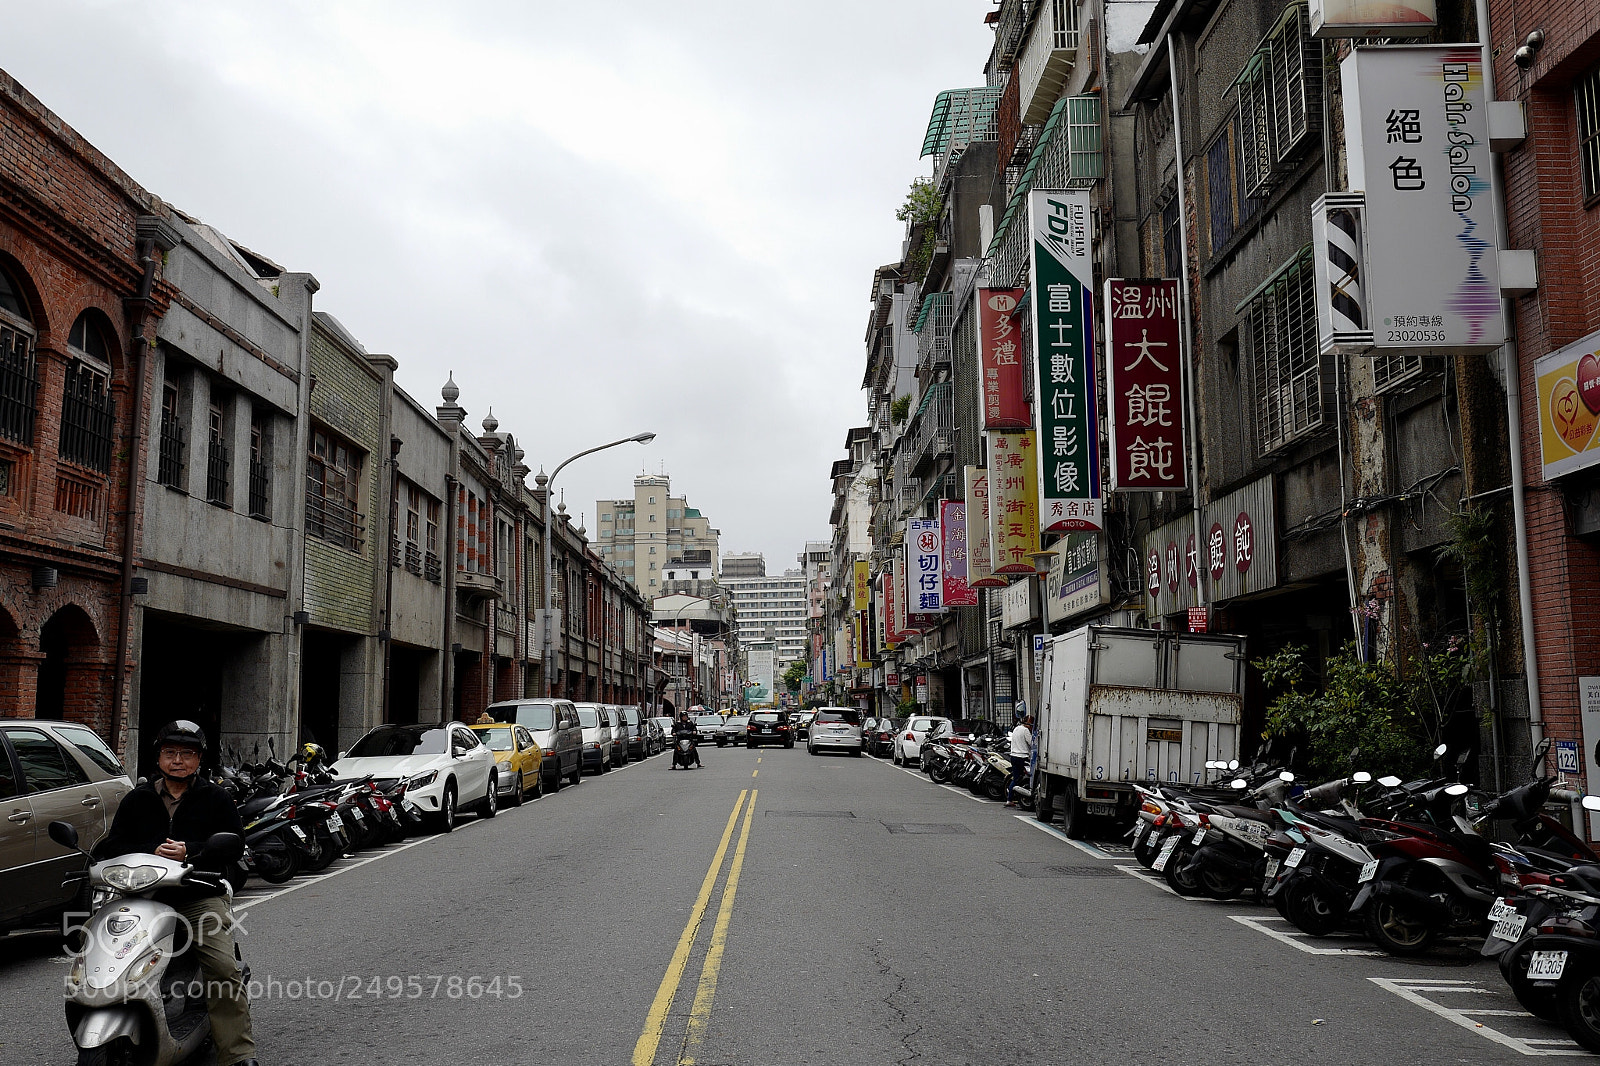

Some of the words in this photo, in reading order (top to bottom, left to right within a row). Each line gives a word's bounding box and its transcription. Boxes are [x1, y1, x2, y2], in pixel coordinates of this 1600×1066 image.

[1442, 62, 1474, 125] Hair
[1385, 108, 1426, 192] 絕色
[1447, 130, 1476, 213] Salon
[1073, 204, 1086, 257] FUJIFILM
[1112, 286, 1177, 320] 溫州
[1393, 315, 1443, 328] 預約專線
[991, 313, 1019, 366] 多禮
[1387, 330, 1446, 343] 23020536
[1046, 282, 1080, 493] 富士數位影像
[1124, 328, 1176, 481] 大餛飩
[1004, 451, 1027, 563] 廣州街玉市
[1050, 500, 1095, 518] 秀舍店
[1061, 520, 1085, 528] PHOTO
[918, 554, 940, 610] 切仔麵
[1558, 753, 1576, 769] 122
